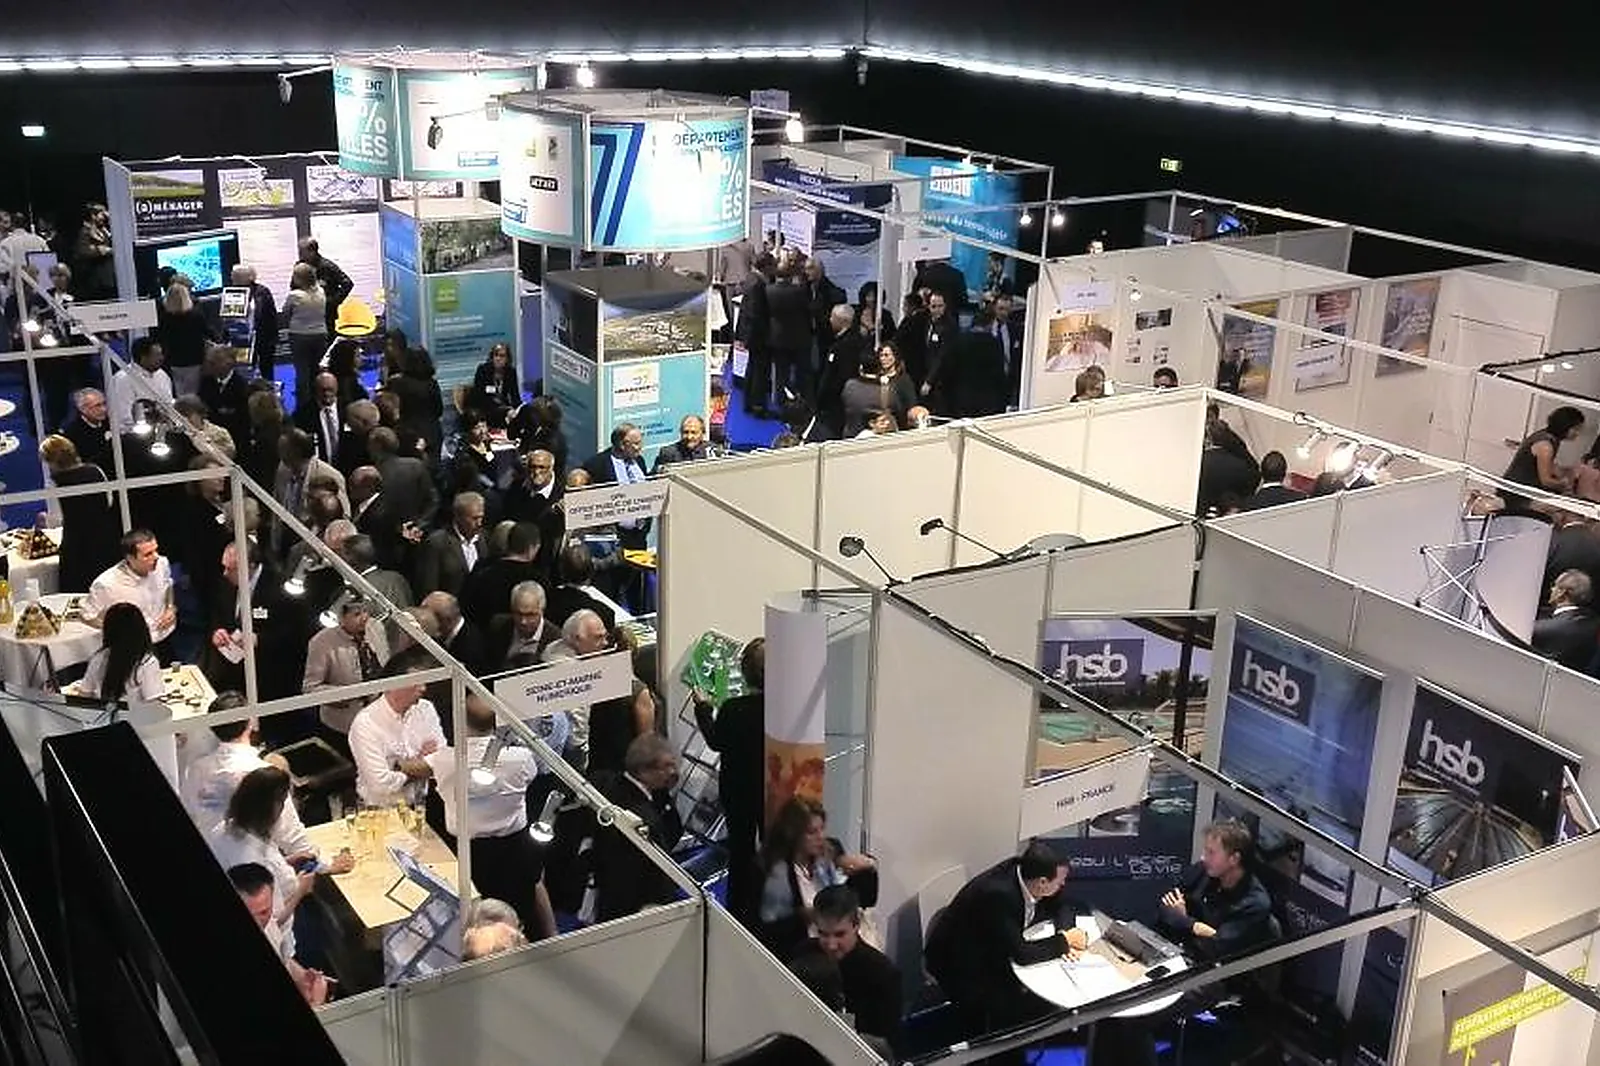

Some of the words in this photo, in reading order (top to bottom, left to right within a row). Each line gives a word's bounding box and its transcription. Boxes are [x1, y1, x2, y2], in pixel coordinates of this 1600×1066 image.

[1060, 643, 1128, 681] hsb
[1242, 649, 1300, 706] hsb
[1419, 719, 1486, 785] hsb
